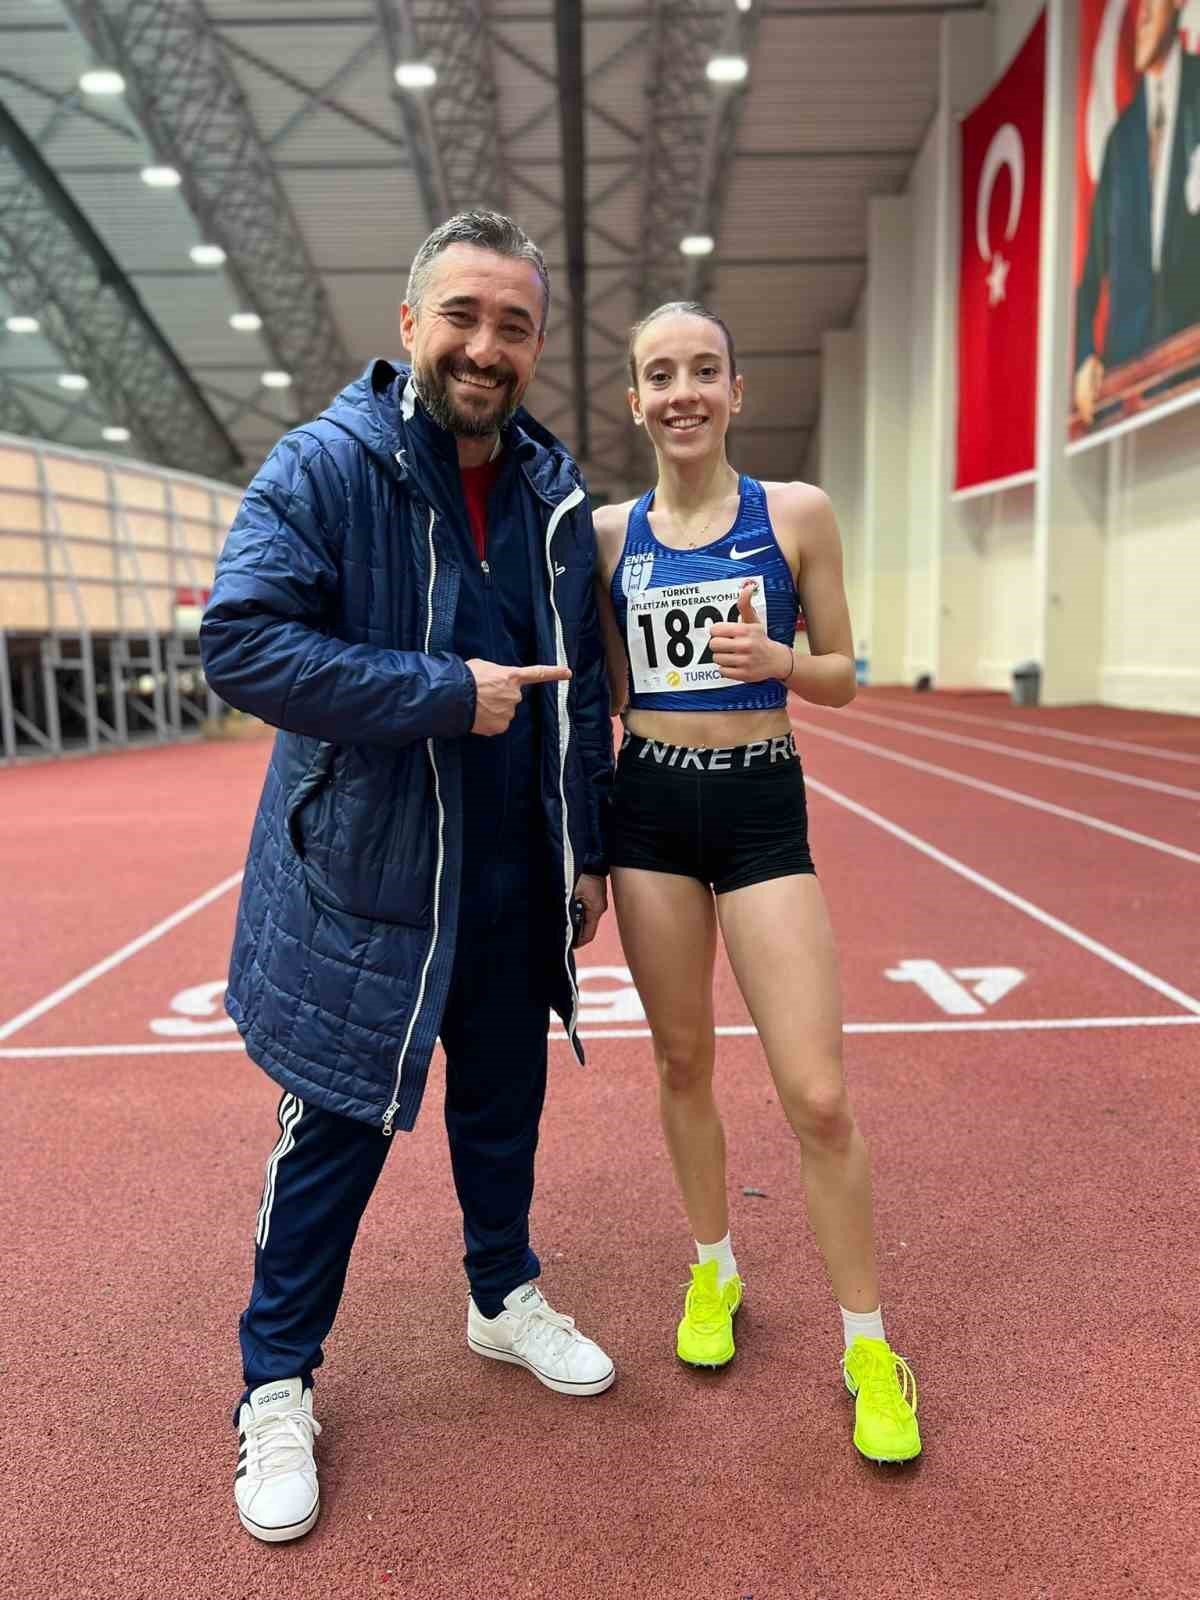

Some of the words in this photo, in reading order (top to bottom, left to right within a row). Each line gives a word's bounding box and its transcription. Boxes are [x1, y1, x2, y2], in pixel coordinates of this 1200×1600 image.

[624, 552, 654, 565] ENKA
[661, 586, 700, 598] TÜRKİYE
[637, 603, 741, 669] 182
[684, 669, 723, 682] TURKC
[638, 738, 735, 770] NIKE
[883, 959, 1026, 1014] 4
[257, 1389, 290, 1405] adidas
